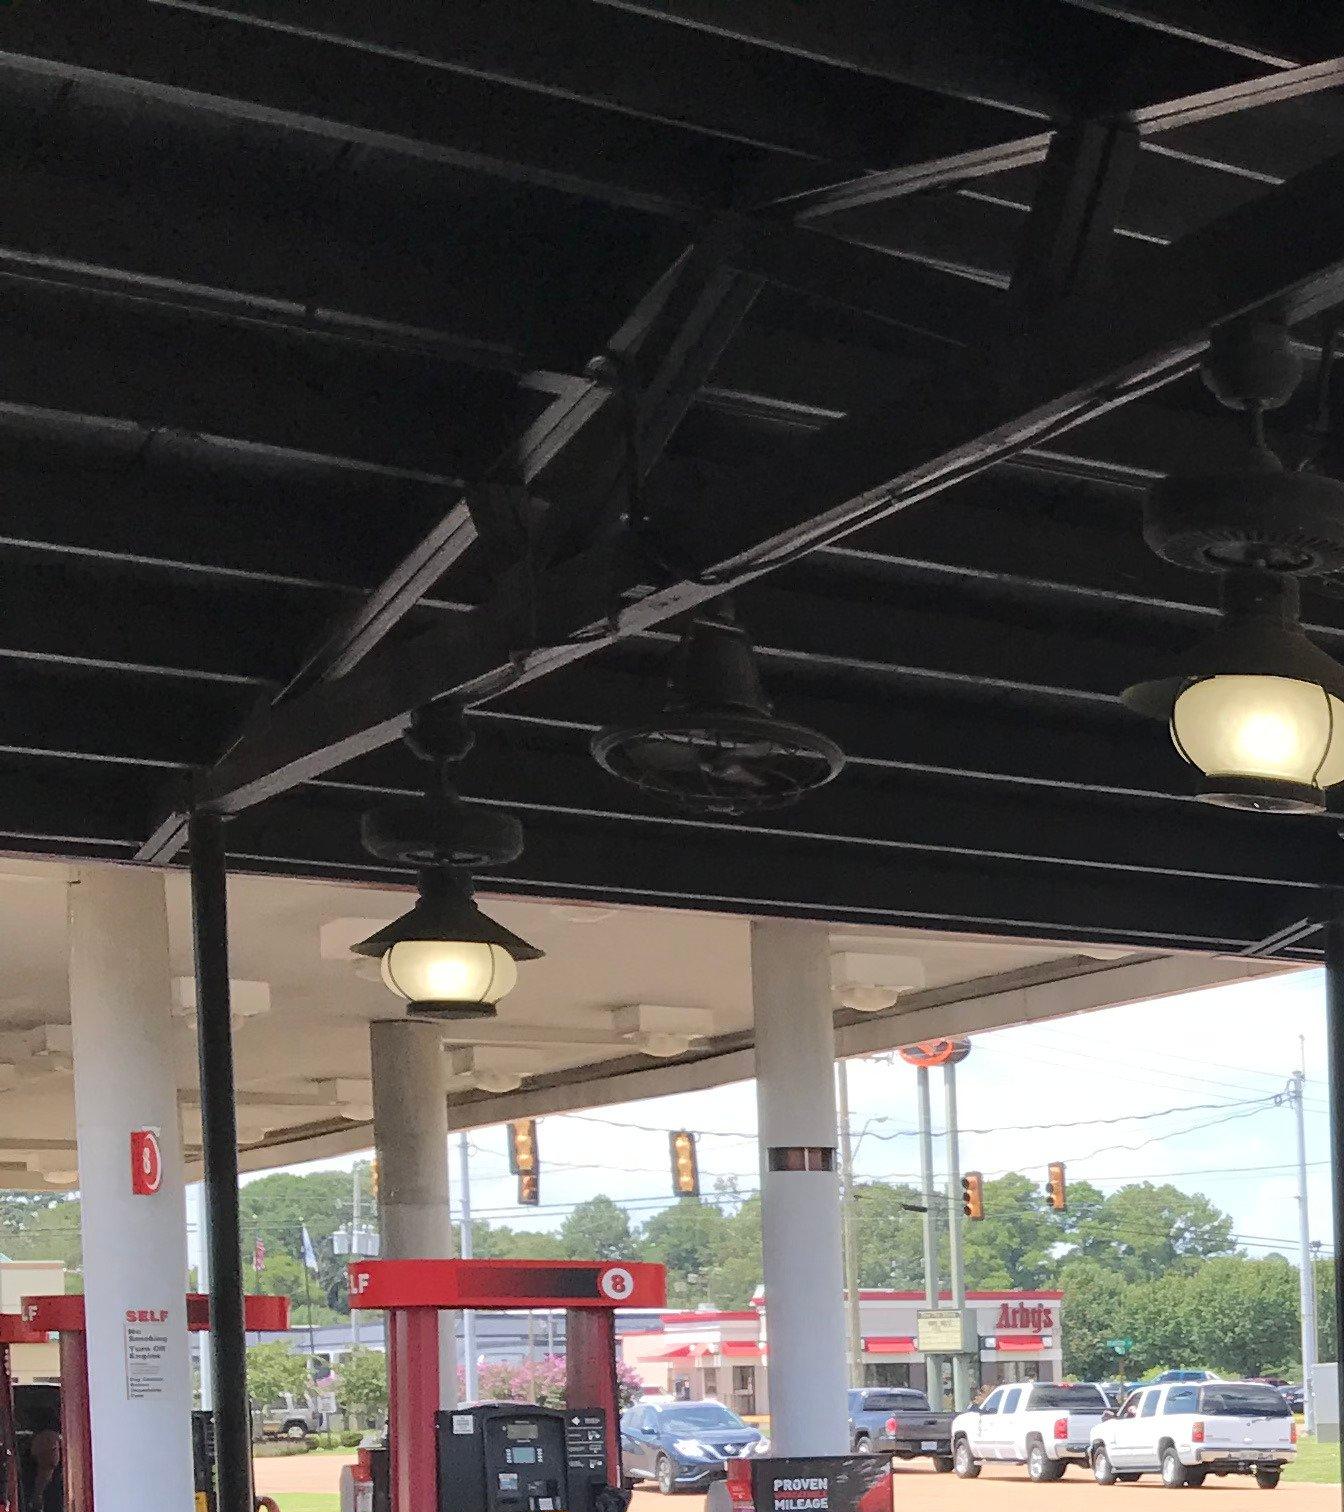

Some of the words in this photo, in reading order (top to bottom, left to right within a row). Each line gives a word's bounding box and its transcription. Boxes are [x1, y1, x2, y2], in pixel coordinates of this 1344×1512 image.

[610, 1274, 626, 1293] 8
[125, 1309, 168, 1322] SELF
[996, 1303, 1054, 1333] Arby's
[773, 1477, 829, 1491] PROVEN
[774, 1497, 829, 1511] MILEAGE
